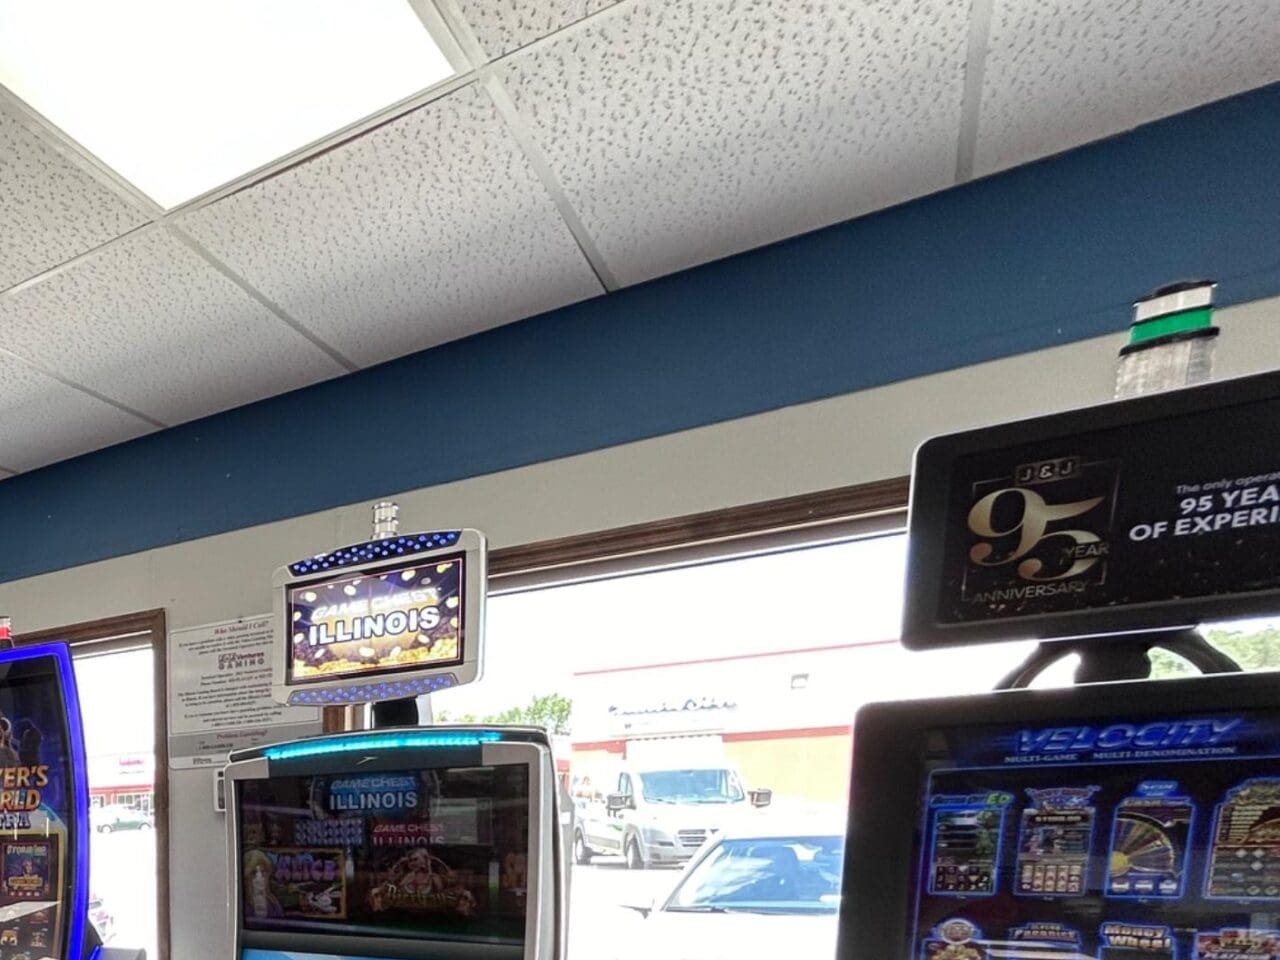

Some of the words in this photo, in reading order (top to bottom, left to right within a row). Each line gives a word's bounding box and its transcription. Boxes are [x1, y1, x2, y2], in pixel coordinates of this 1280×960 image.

[1180, 495, 1213, 515] 95
[967, 487, 1105, 581] 95
[1129, 520, 1169, 542] OF
[1065, 542, 1110, 559] YEAR
[972, 580, 1089, 603] ANNIVERSARY
[309, 606, 441, 647] ILLINOIS
[218, 658, 264, 670] GAMING
[1018, 718, 1241, 752] VELOCITY
[1004, 753, 1079, 764] MULTI-GAME
[330, 778, 370, 790] GAME
[329, 791, 418, 811] ILLINOIS
[1104, 922, 1165, 938] Money
[1109, 935, 1171, 951] Wheel
